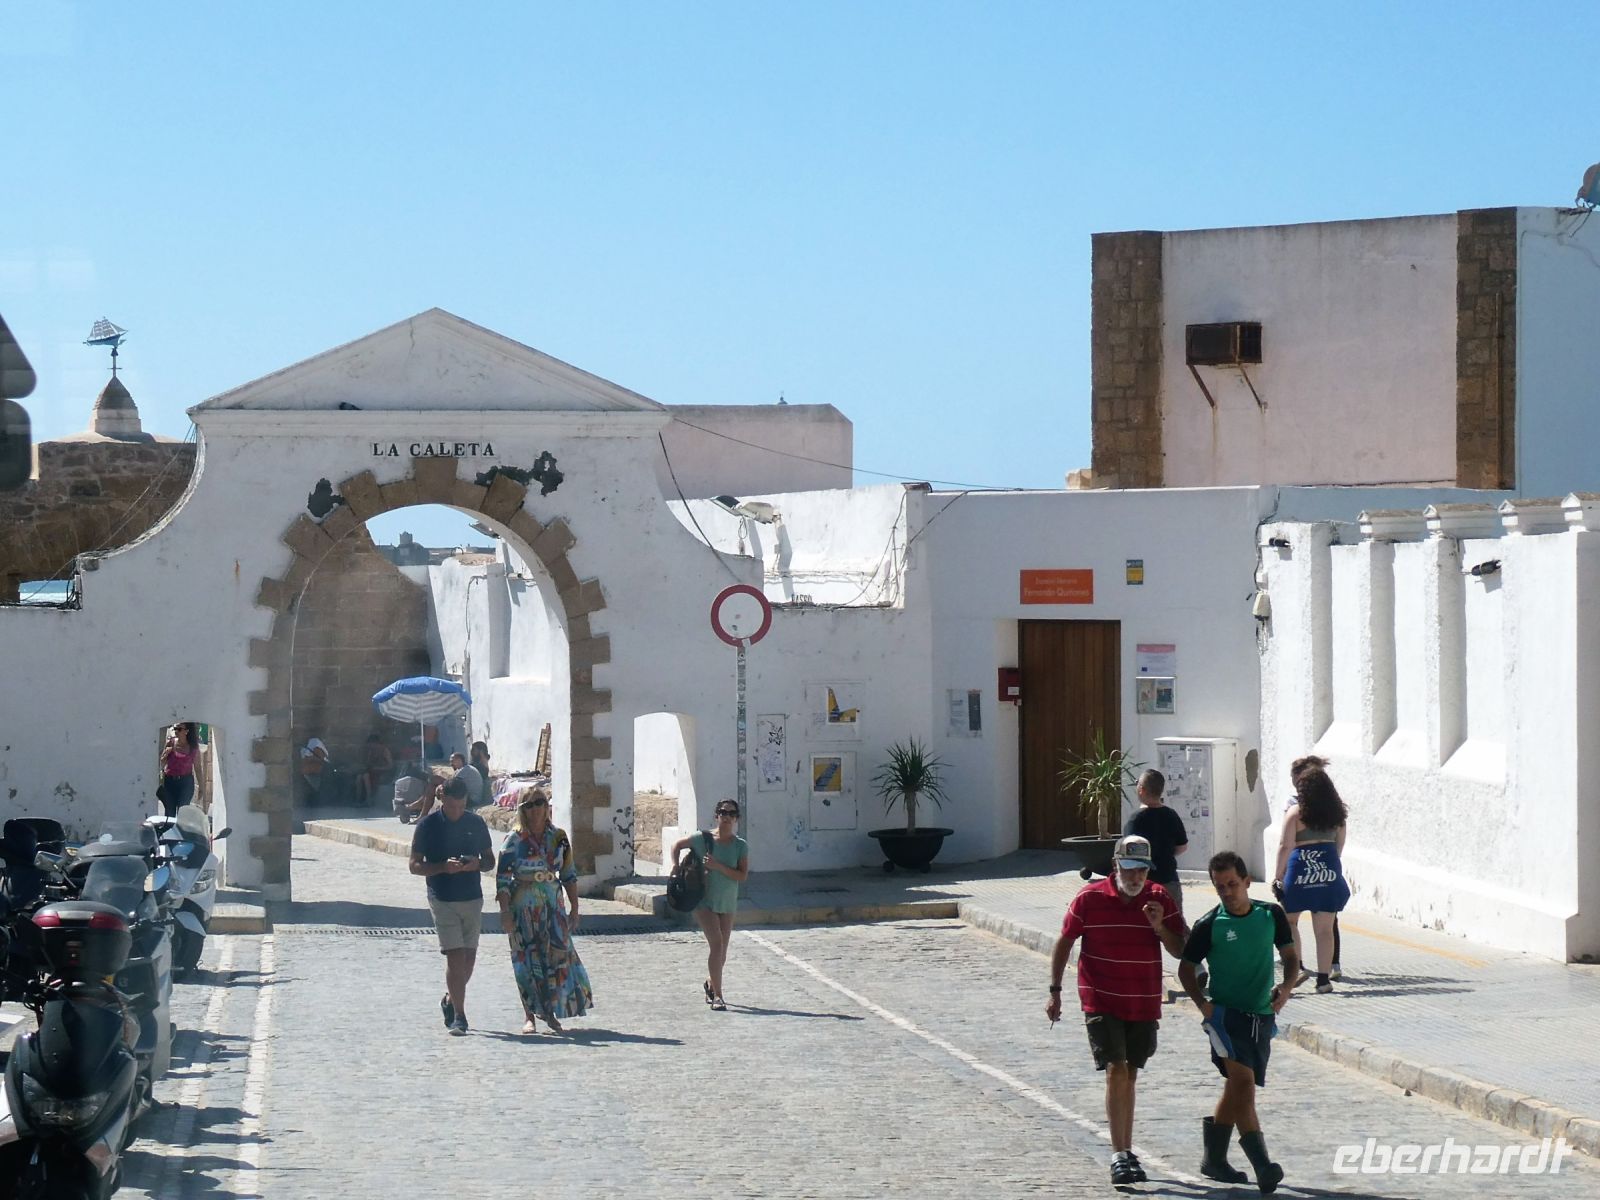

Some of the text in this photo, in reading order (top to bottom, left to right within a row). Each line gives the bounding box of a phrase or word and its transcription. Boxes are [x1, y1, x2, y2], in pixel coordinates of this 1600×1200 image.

[372, 442, 495, 457] LA CALETA
[1294, 868, 1337, 885] MOOD
